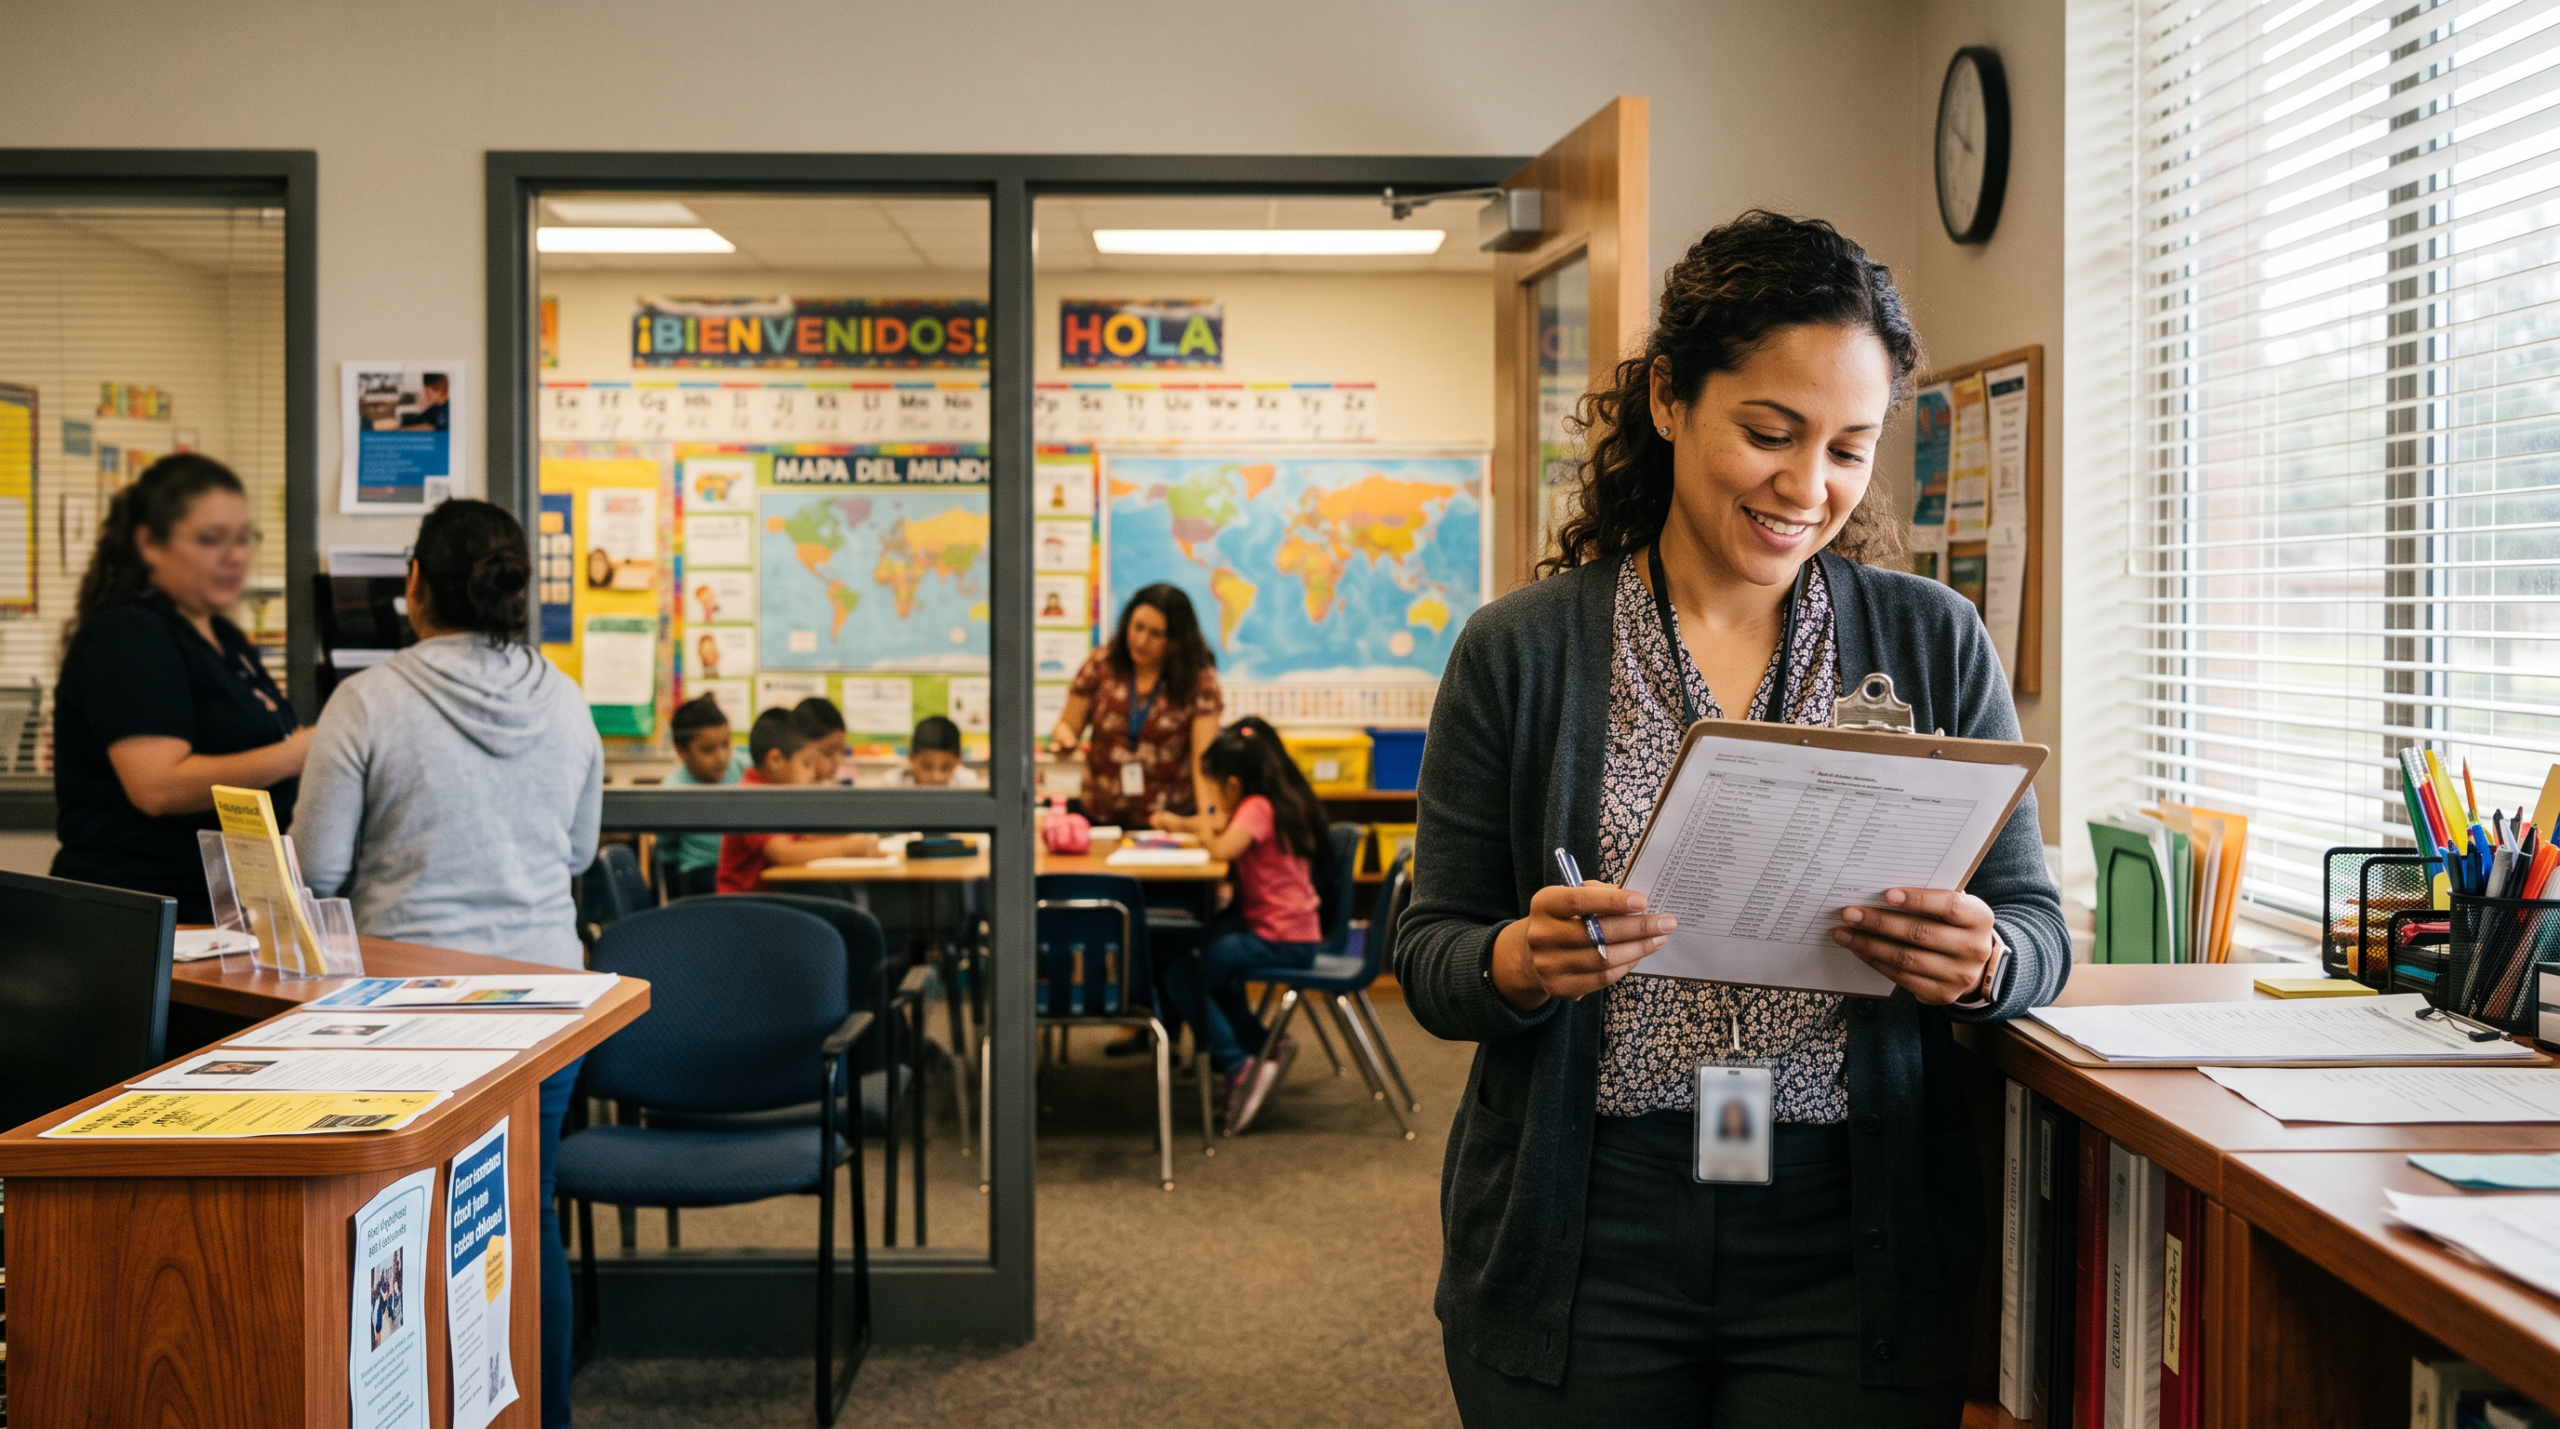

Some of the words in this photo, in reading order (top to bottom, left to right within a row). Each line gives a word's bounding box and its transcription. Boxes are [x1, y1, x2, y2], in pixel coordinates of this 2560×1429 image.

[637, 315, 988, 355] ¡BIENVENIDOS!
[1065, 313, 1219, 357] HOLA
[774, 456, 850, 483] MAPA
[855, 456, 901, 483] DEL
